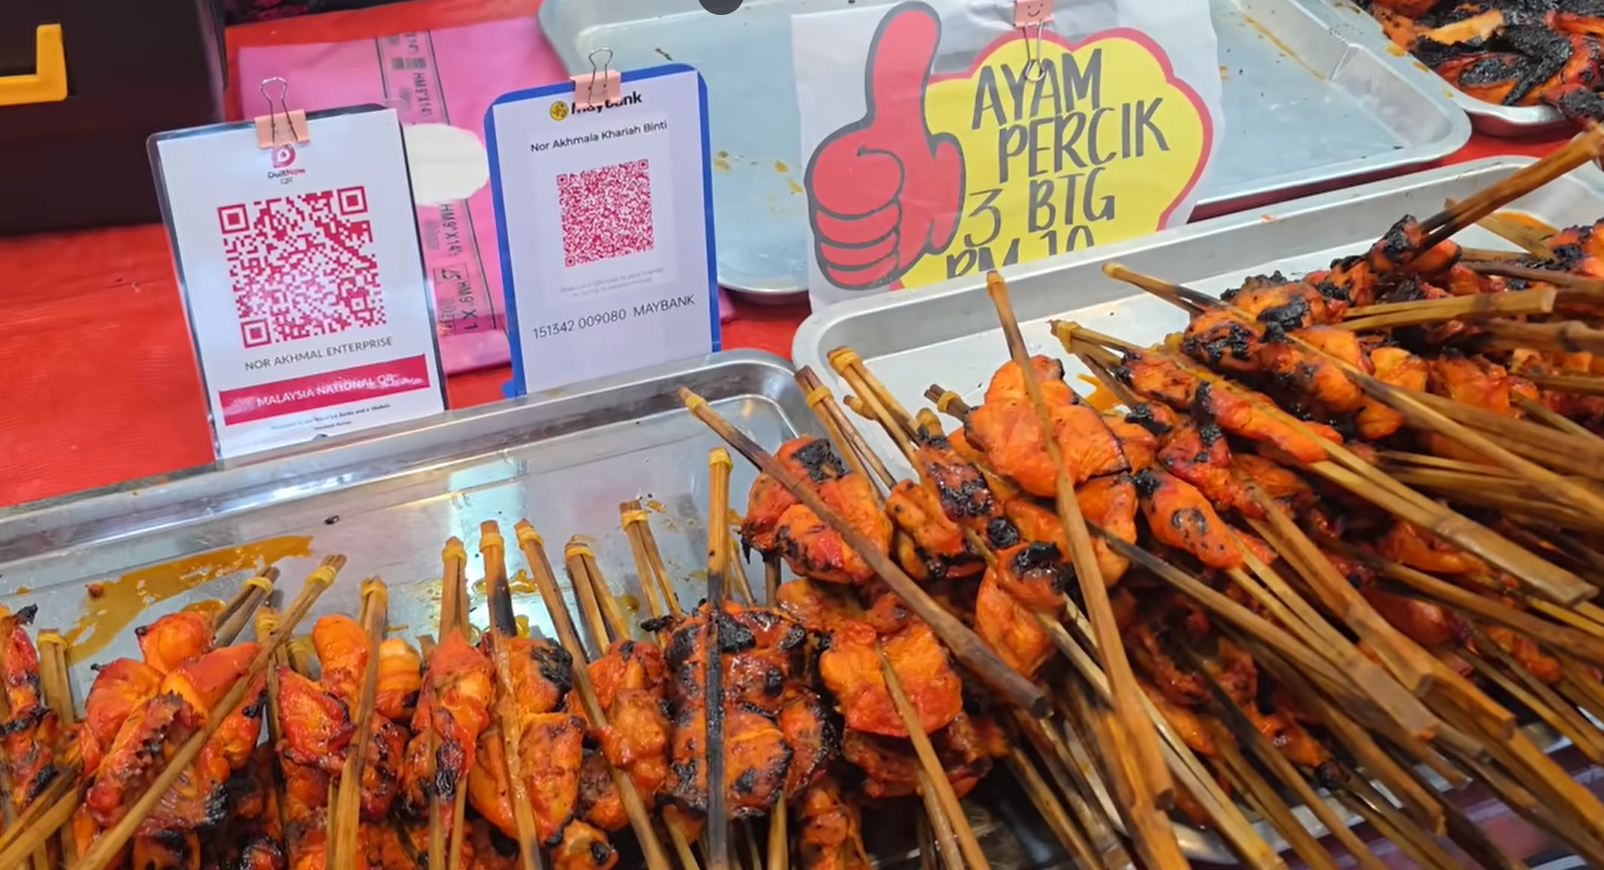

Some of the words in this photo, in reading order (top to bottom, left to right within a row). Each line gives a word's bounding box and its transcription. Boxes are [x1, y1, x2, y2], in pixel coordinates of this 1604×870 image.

[971, 48, 1102, 130] AYAM
[530, 140, 550, 152] Nor
[552, 132, 599, 148] Akhmala
[601, 124, 641, 140] Khariah
[643, 120, 668, 133] Binti
[998, 97, 1170, 184] PERCIK
[963, 187, 1004, 248] 3
[1028, 166, 1115, 233] BTG
[533, 319, 574, 339] 151342
[578, 308, 627, 329] 009080
[633, 293, 696, 317] MAYBANK
[244, 357, 271, 371] NOR
[274, 348, 323, 366] AKHMAL
[326, 336, 393, 357] ENTERPRISE
[256, 388, 315, 407] MALAYSIA
[317, 376, 373, 396] NATIONAL
